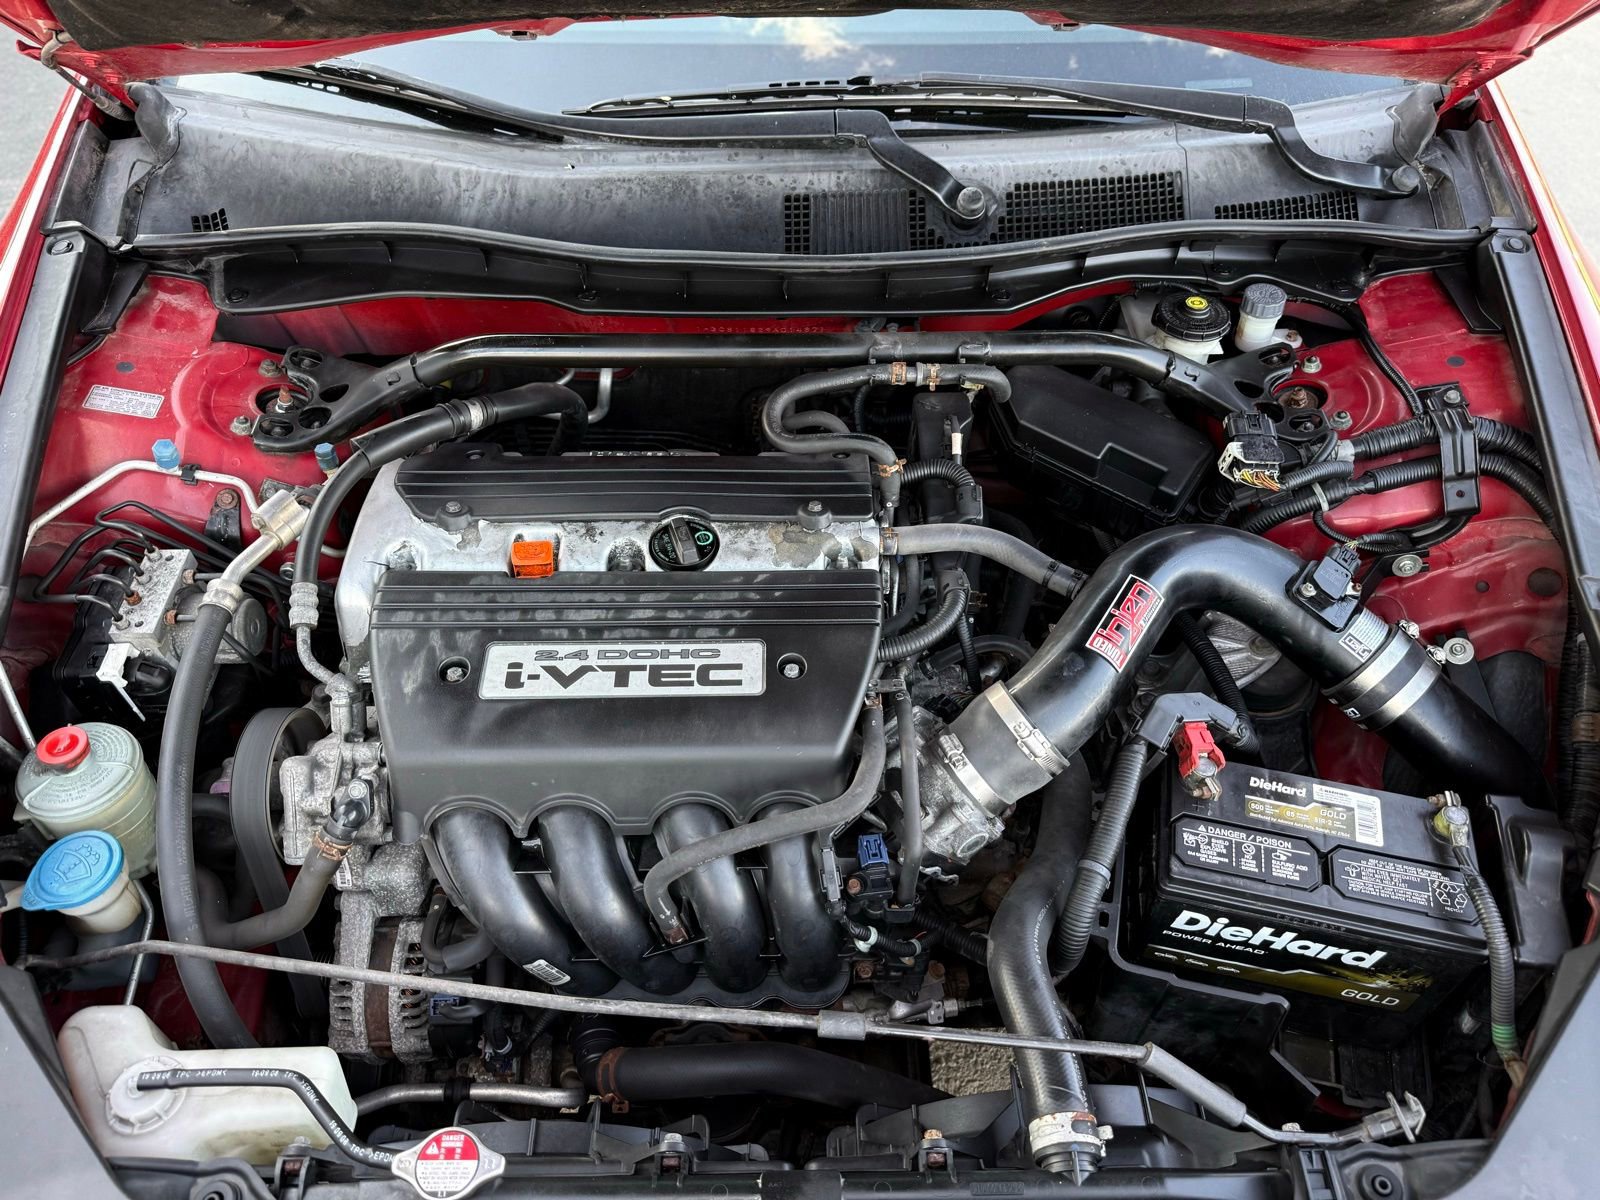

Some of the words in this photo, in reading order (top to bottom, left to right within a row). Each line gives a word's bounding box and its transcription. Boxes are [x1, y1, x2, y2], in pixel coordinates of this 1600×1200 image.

[1098, 580, 1153, 650] injen
[534, 650, 590, 661] 2.4
[597, 648, 720, 660] DOHC
[504, 662, 742, 690] i-VTEC
[1250, 776, 1306, 798] DieHard
[1320, 810, 1346, 820] GOLD
[1208, 826, 1246, 840] DANGER
[1256, 837, 1291, 849] POISON
[1390, 873, 1420, 882] IMMEDIATELY
[1162, 929, 1212, 944] POWER
[1215, 940, 1265, 955] AHEAD
[1170, 909, 1388, 969] DieHard
[1340, 988, 1400, 1006] GOLD
[350, 1144, 365, 1156] TPC
